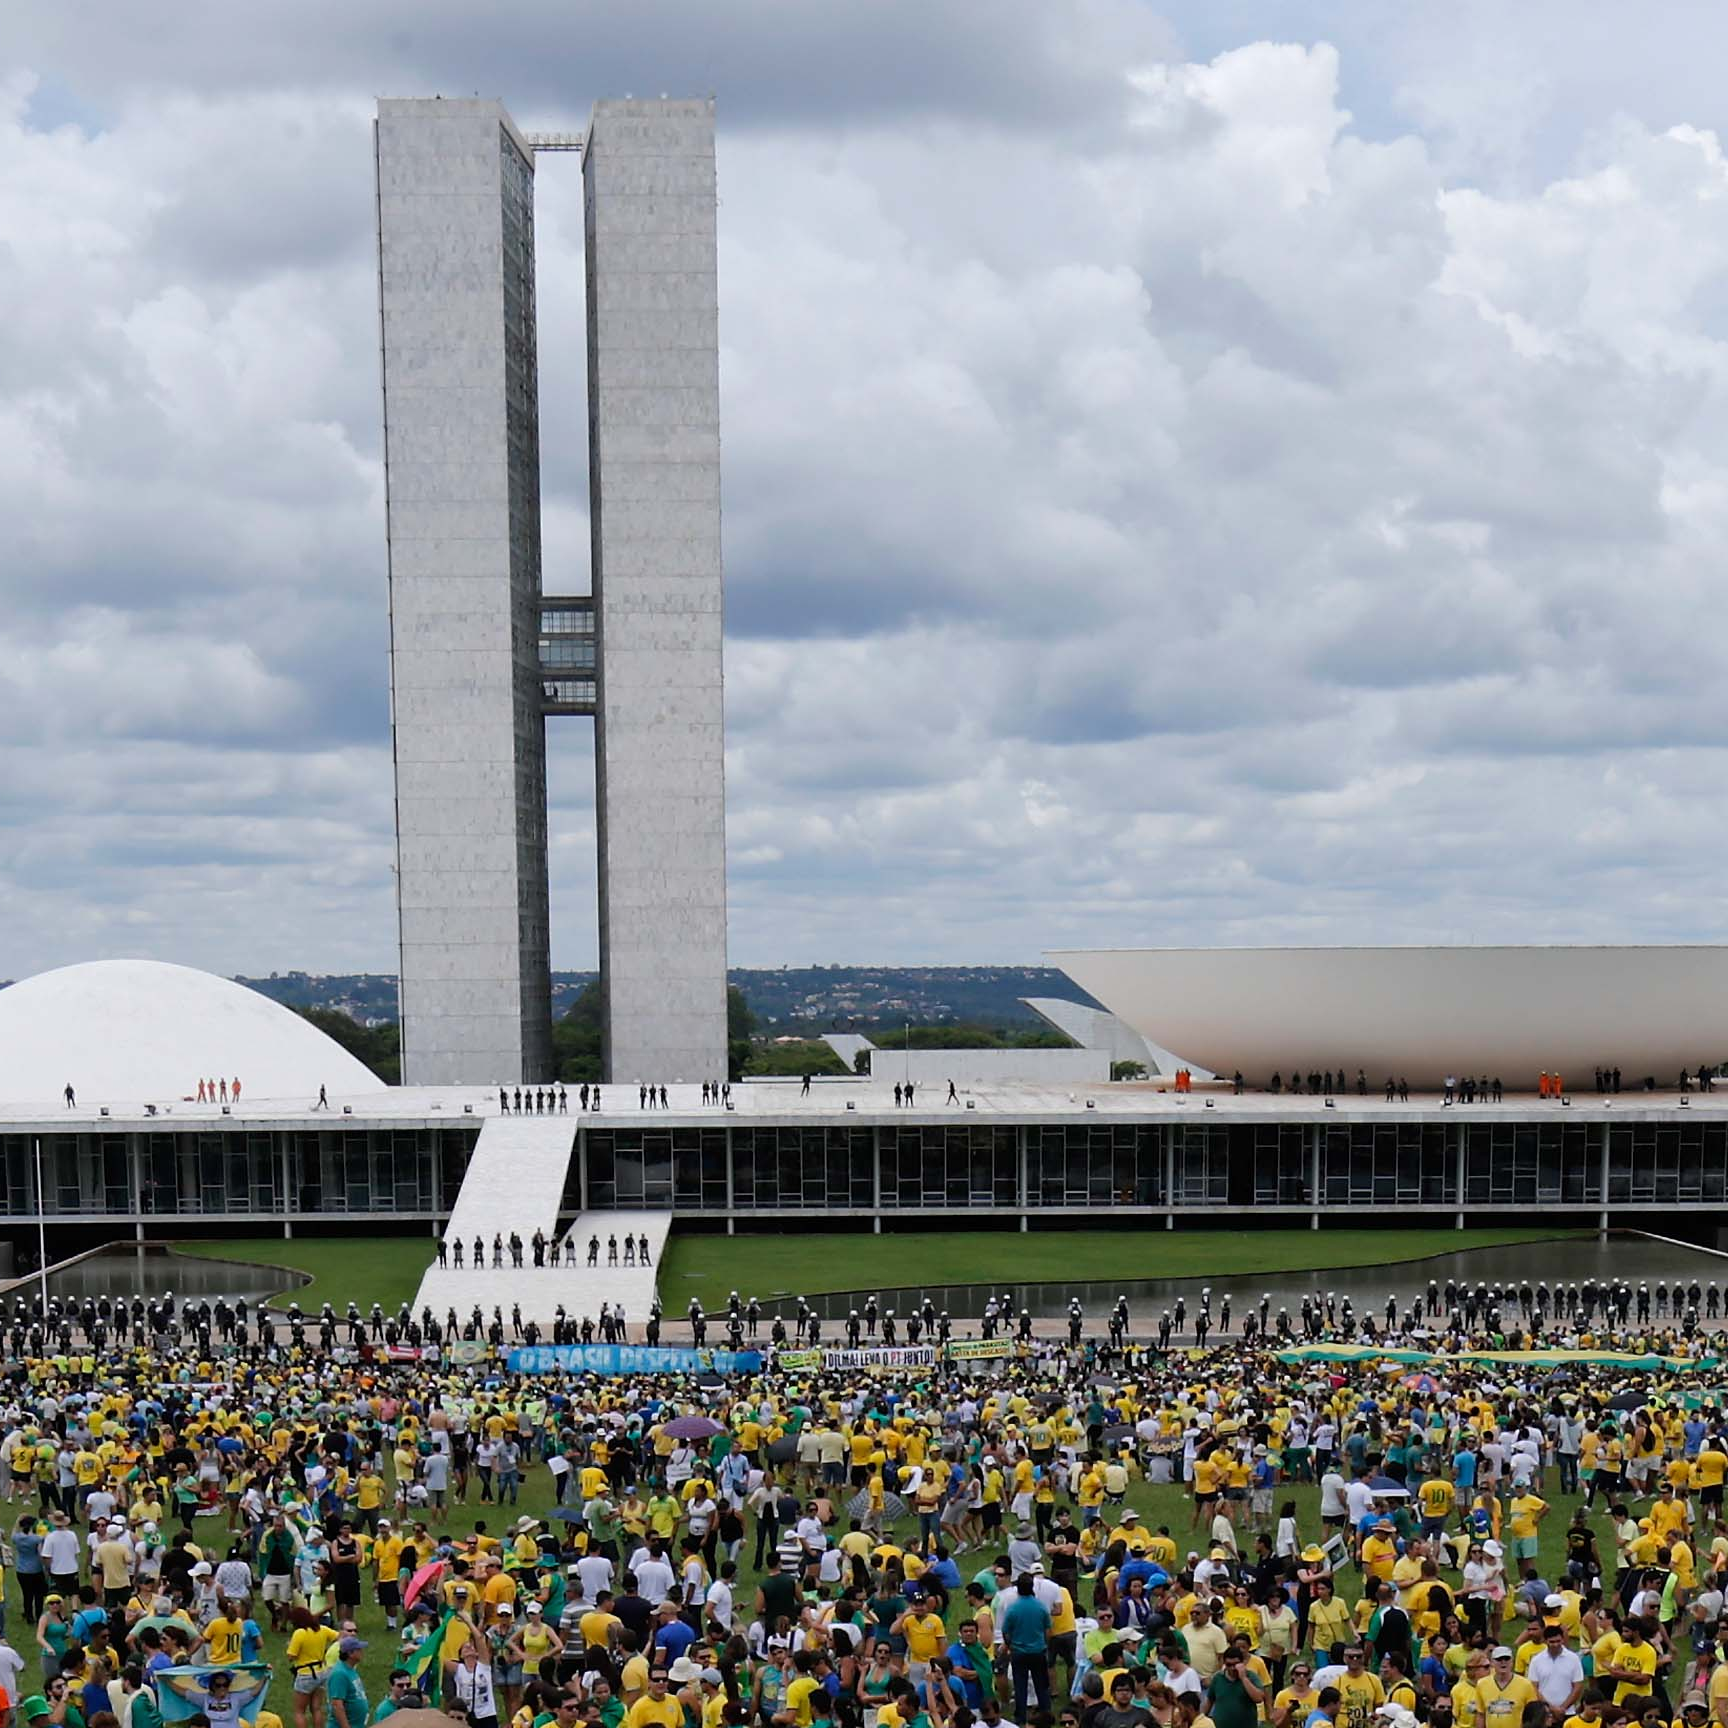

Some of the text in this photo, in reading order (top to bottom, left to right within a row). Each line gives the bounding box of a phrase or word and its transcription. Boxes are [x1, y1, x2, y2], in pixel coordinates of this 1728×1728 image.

[828, 1350, 859, 1368] DILMA!
[890, 1349, 902, 1366] PT
[903, 1348, 934, 1366] JUNTO!
[225, 1632, 239, 1654] 10
